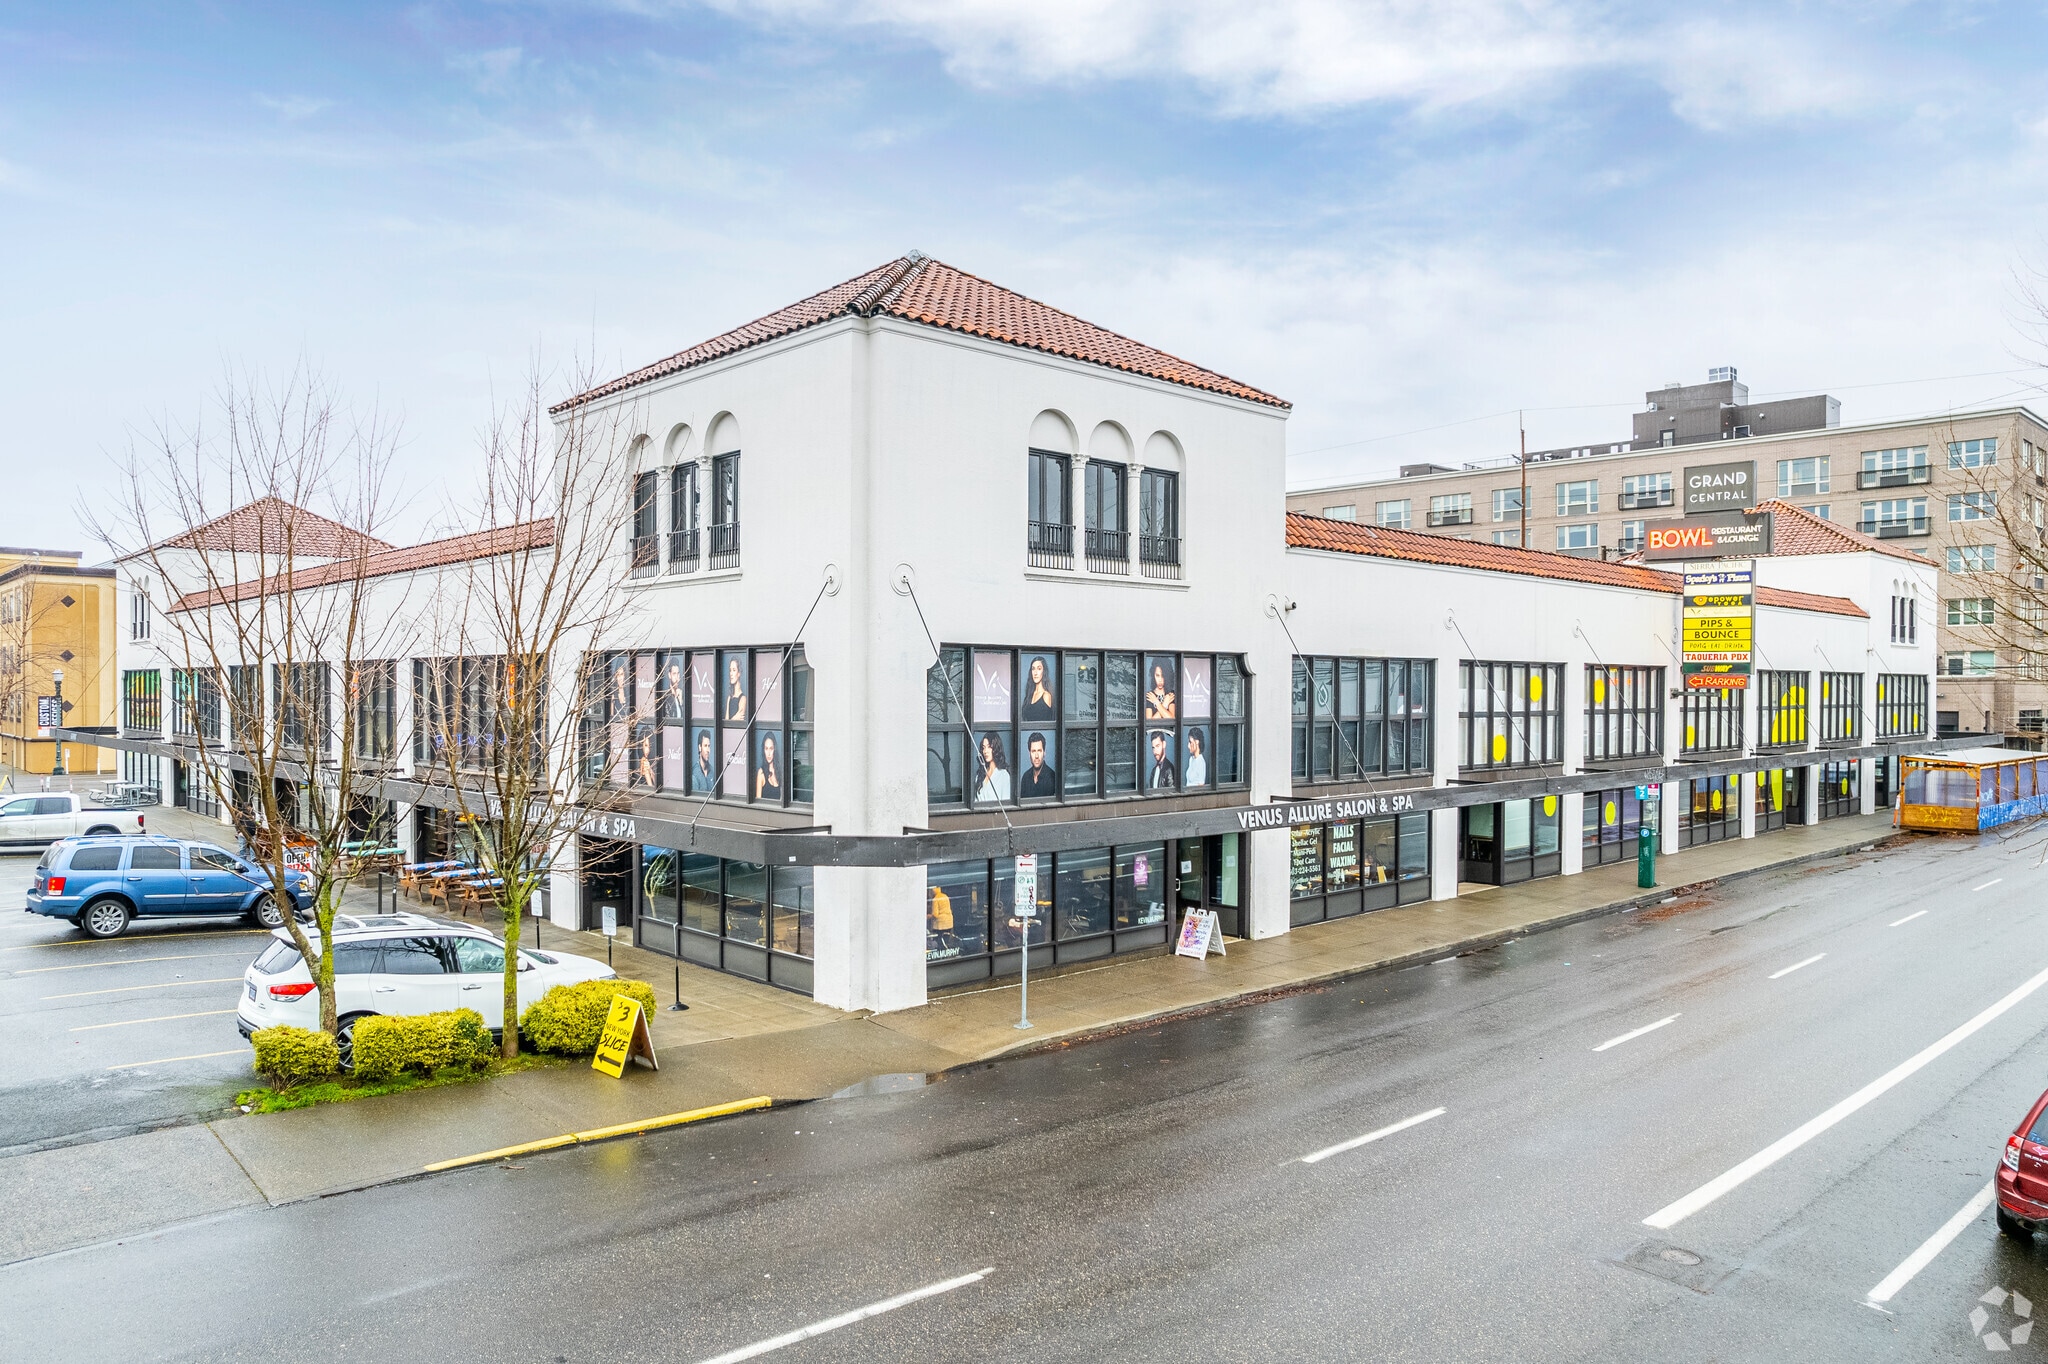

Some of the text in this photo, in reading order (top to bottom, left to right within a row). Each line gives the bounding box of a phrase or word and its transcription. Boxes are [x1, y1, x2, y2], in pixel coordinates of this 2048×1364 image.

[1689, 471, 1747, 489] GRAND
[1689, 489, 1747, 503] CENTRAL
[1711, 524, 1763, 536] RESTAURANT
[1649, 526, 1713, 549] BOWL
[1700, 619, 1733, 628] PIPS &
[1694, 630, 1739, 639] BOUNCE
[1685, 653, 1748, 661] TAQUERIA PDX
[1700, 664, 1733, 673] SUBWAY
[1237, 794, 1414, 829] VENUS ALLURE SALON & SPA
[600, 816, 608, 834] &
[612, 817, 636, 839] SPA
[1333, 824, 1354, 840] NAILS
[1332, 840, 1354, 854] FACIAL
[1329, 854, 1357, 869] WAXING
[599, 1033, 629, 1052] SLICE
